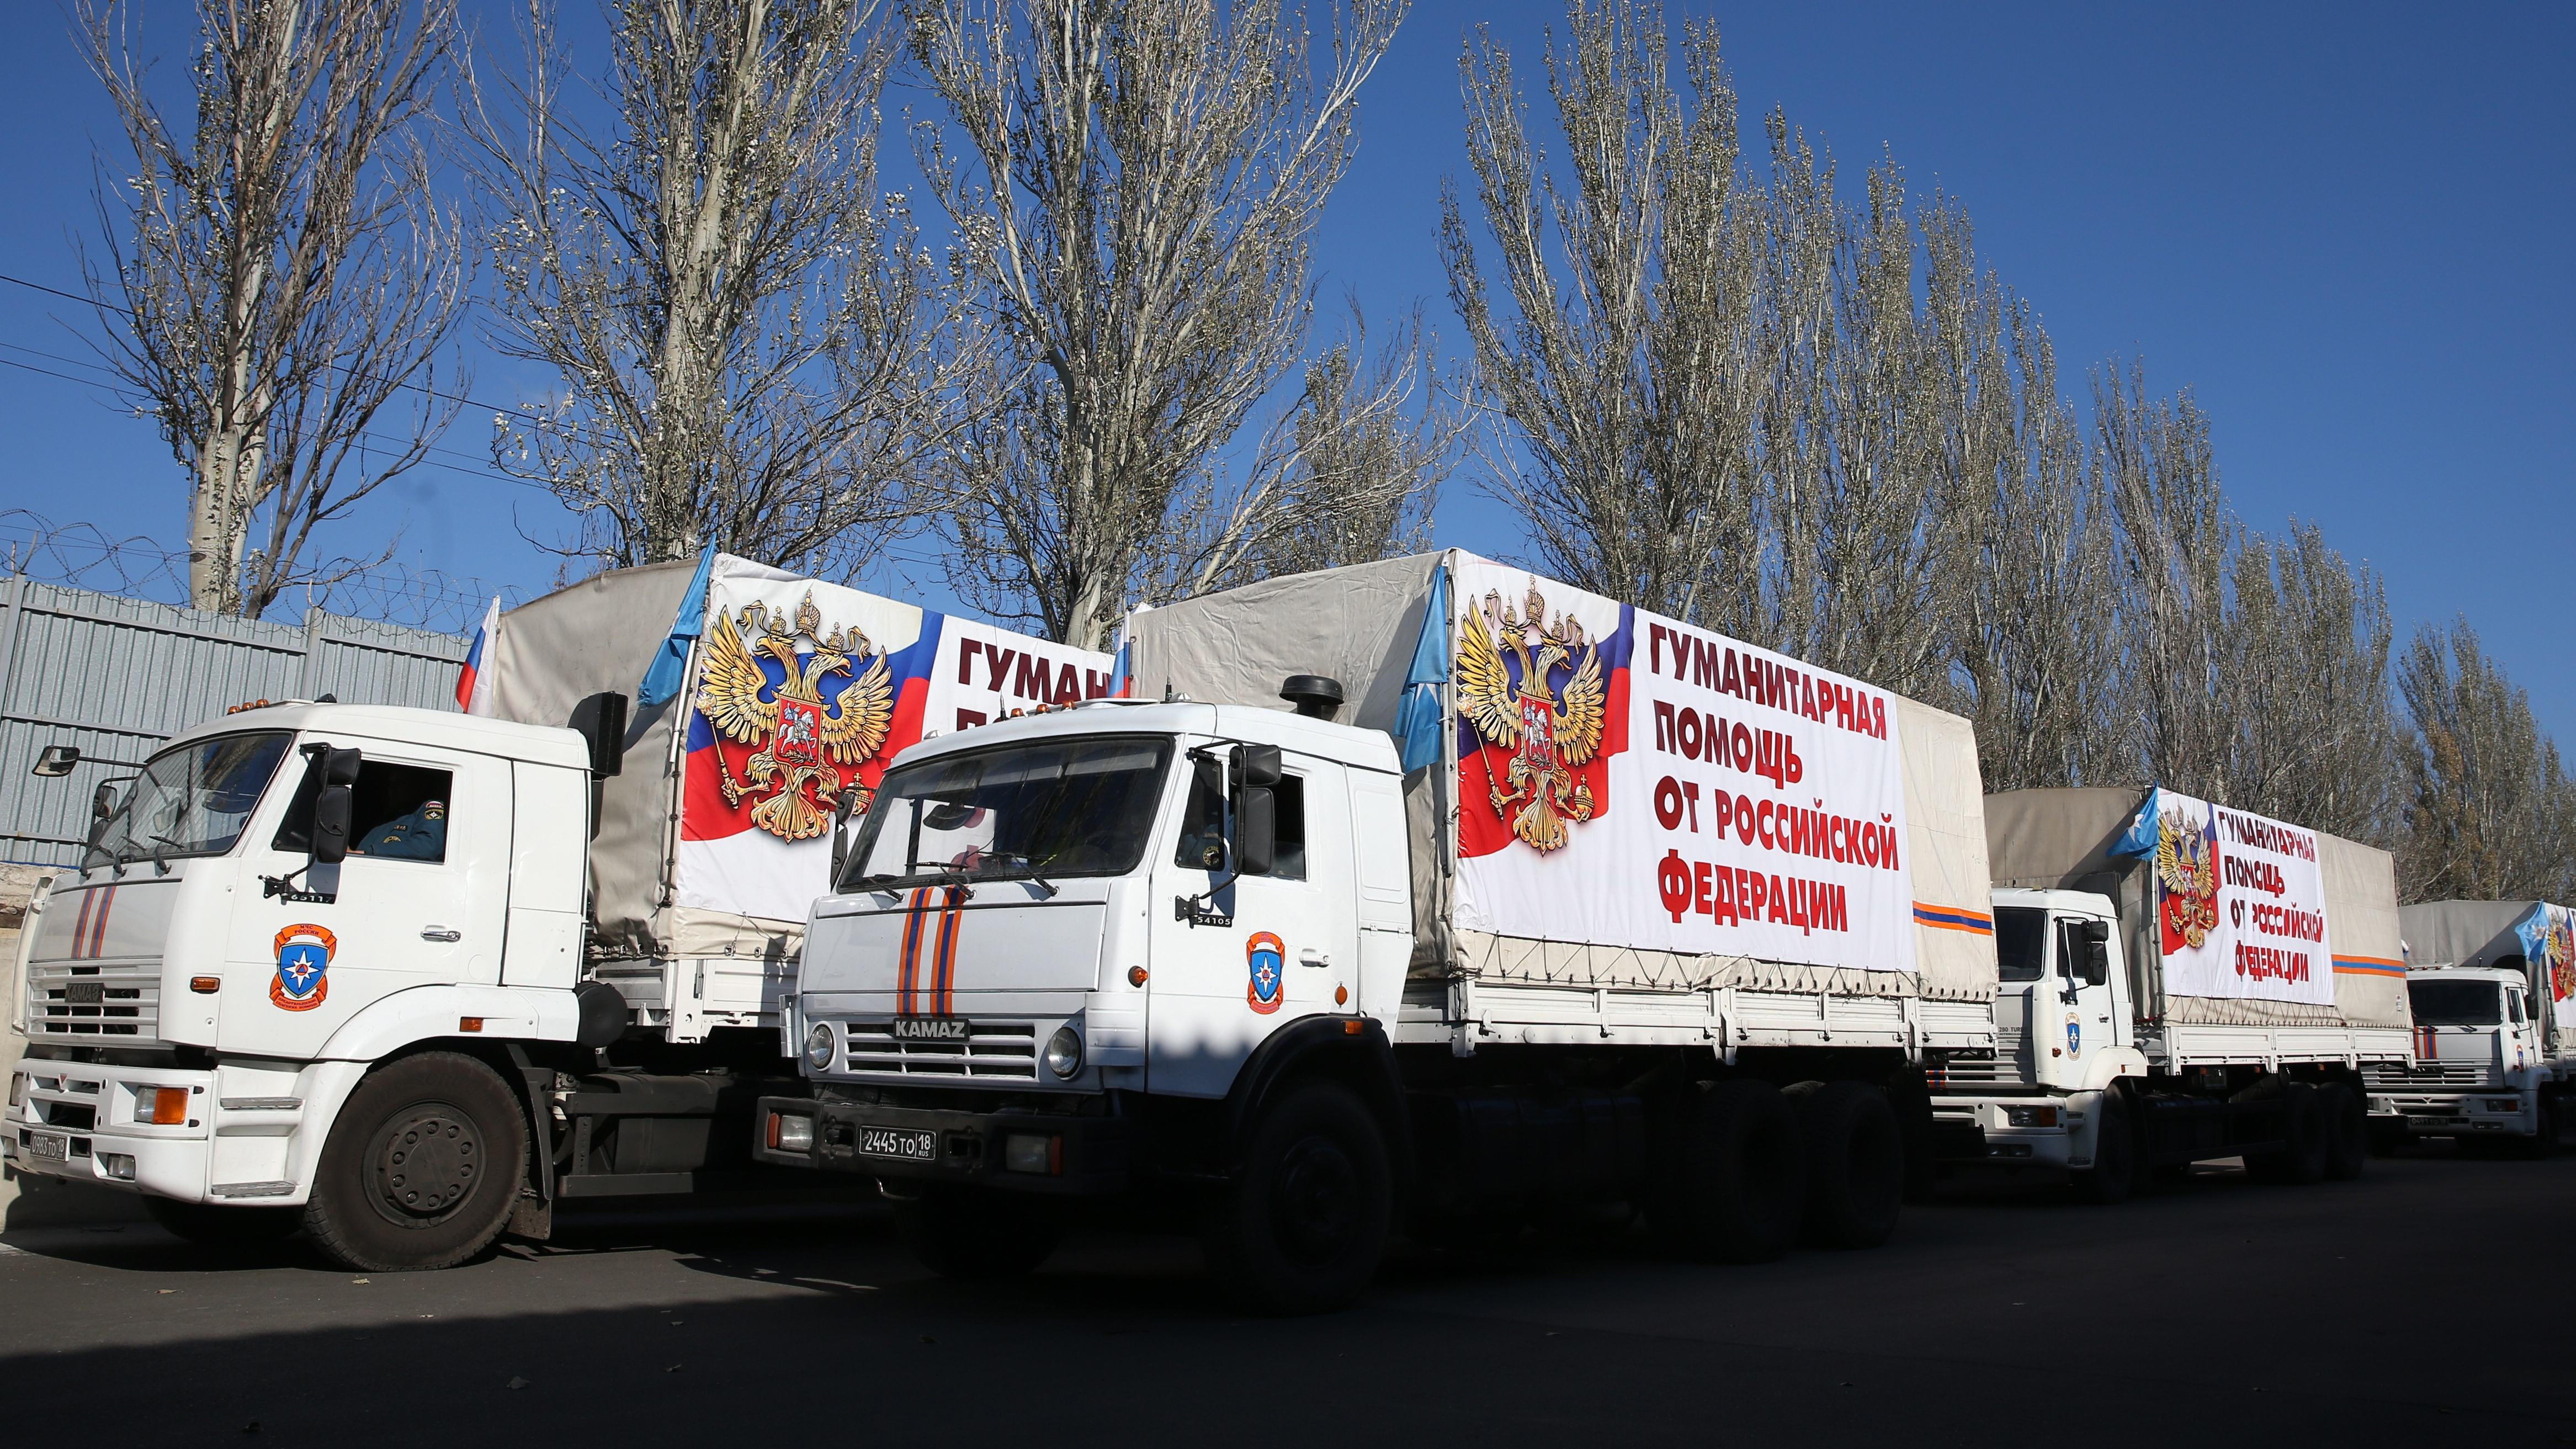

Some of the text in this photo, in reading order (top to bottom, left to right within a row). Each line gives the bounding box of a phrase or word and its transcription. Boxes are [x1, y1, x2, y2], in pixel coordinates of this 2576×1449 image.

[1649, 622, 1887, 741] ГУМАНИТАРНАЯ
[1653, 699, 1803, 790] ПОМОЩЬ
[1654, 775, 1900, 872] ОТ РОССИЙСКОЙ
[2218, 811, 2316, 863] ГУМАНИТАРНАЯ
[1658, 848, 1849, 937] ФЕДЕРАЦИИ
[2224, 855, 2286, 898] ПОМОЩЬ
[1197, 916, 1231, 925] 54105
[2230, 898, 2323, 943] ОТ РОССИЙСКОЙ
[2235, 940, 2309, 985] ФЕДЕРАЦИИ
[895, 1021, 965, 1038] KAMAZ
[32, 1135, 48, 1155] 0983
[57, 1138, 65, 1153] 18
[864, 1130, 931, 1155] 2445 ТО 18
